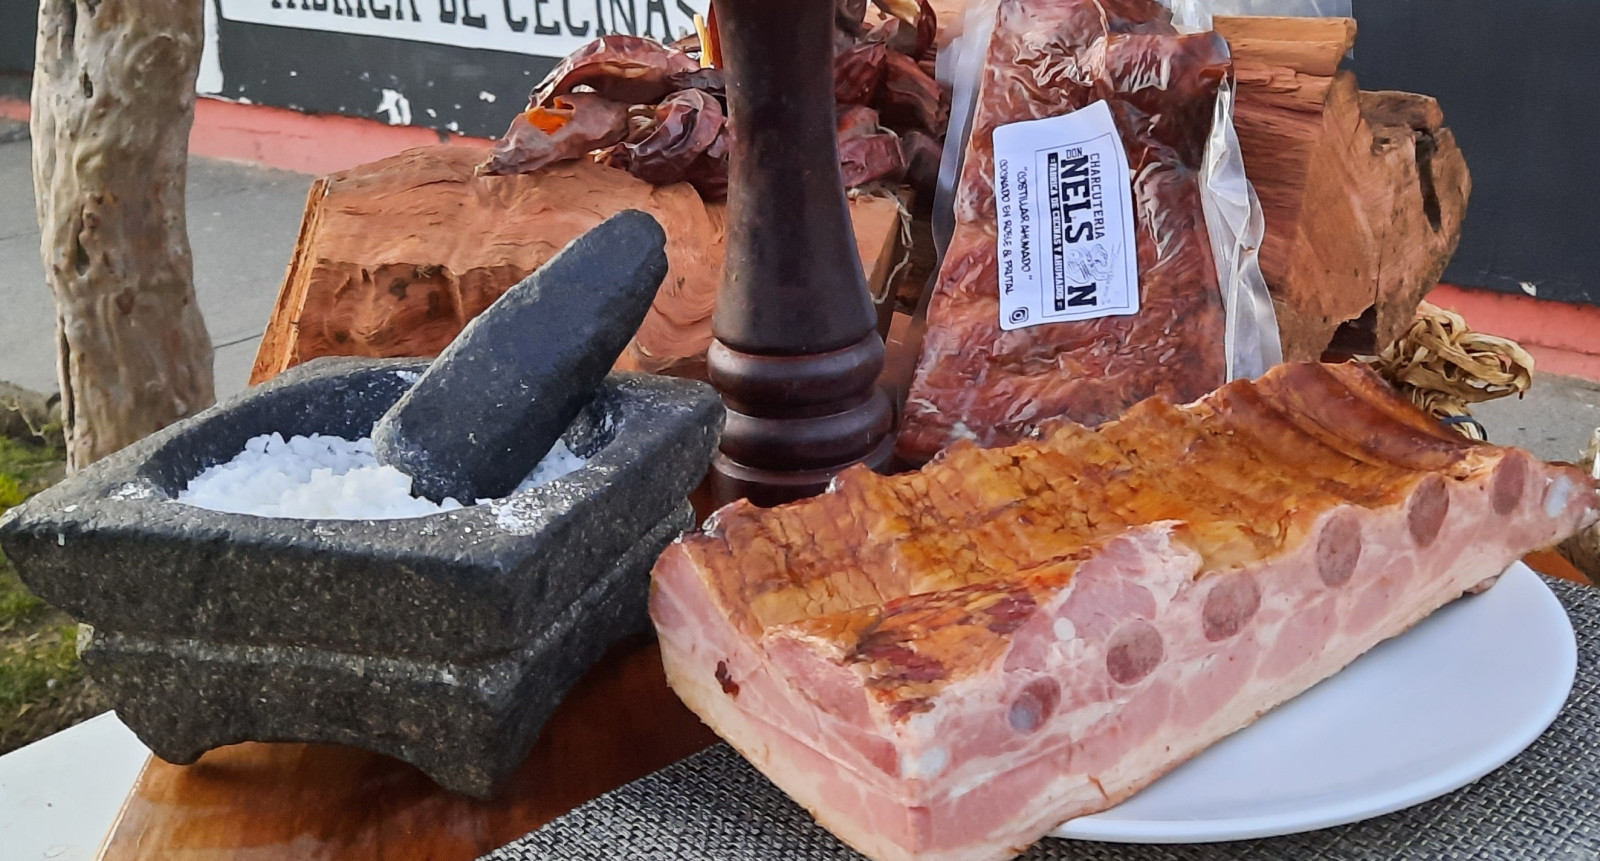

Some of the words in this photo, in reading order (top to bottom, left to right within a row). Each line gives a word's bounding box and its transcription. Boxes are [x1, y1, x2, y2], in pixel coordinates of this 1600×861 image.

[1065, 147, 1083, 159] DON
[999, 159, 1011, 203] COCINADO
[1090, 153, 1105, 240] CHARCUTERIA
[1002, 205, 1011, 217] EN
[1051, 199, 1061, 209] DE
[1052, 211, 1062, 245] CECINAS
[1061, 155, 1097, 307] NELSN
[1002, 250, 1012, 258] &
[1054, 255, 1064, 300] AHUMADOS
